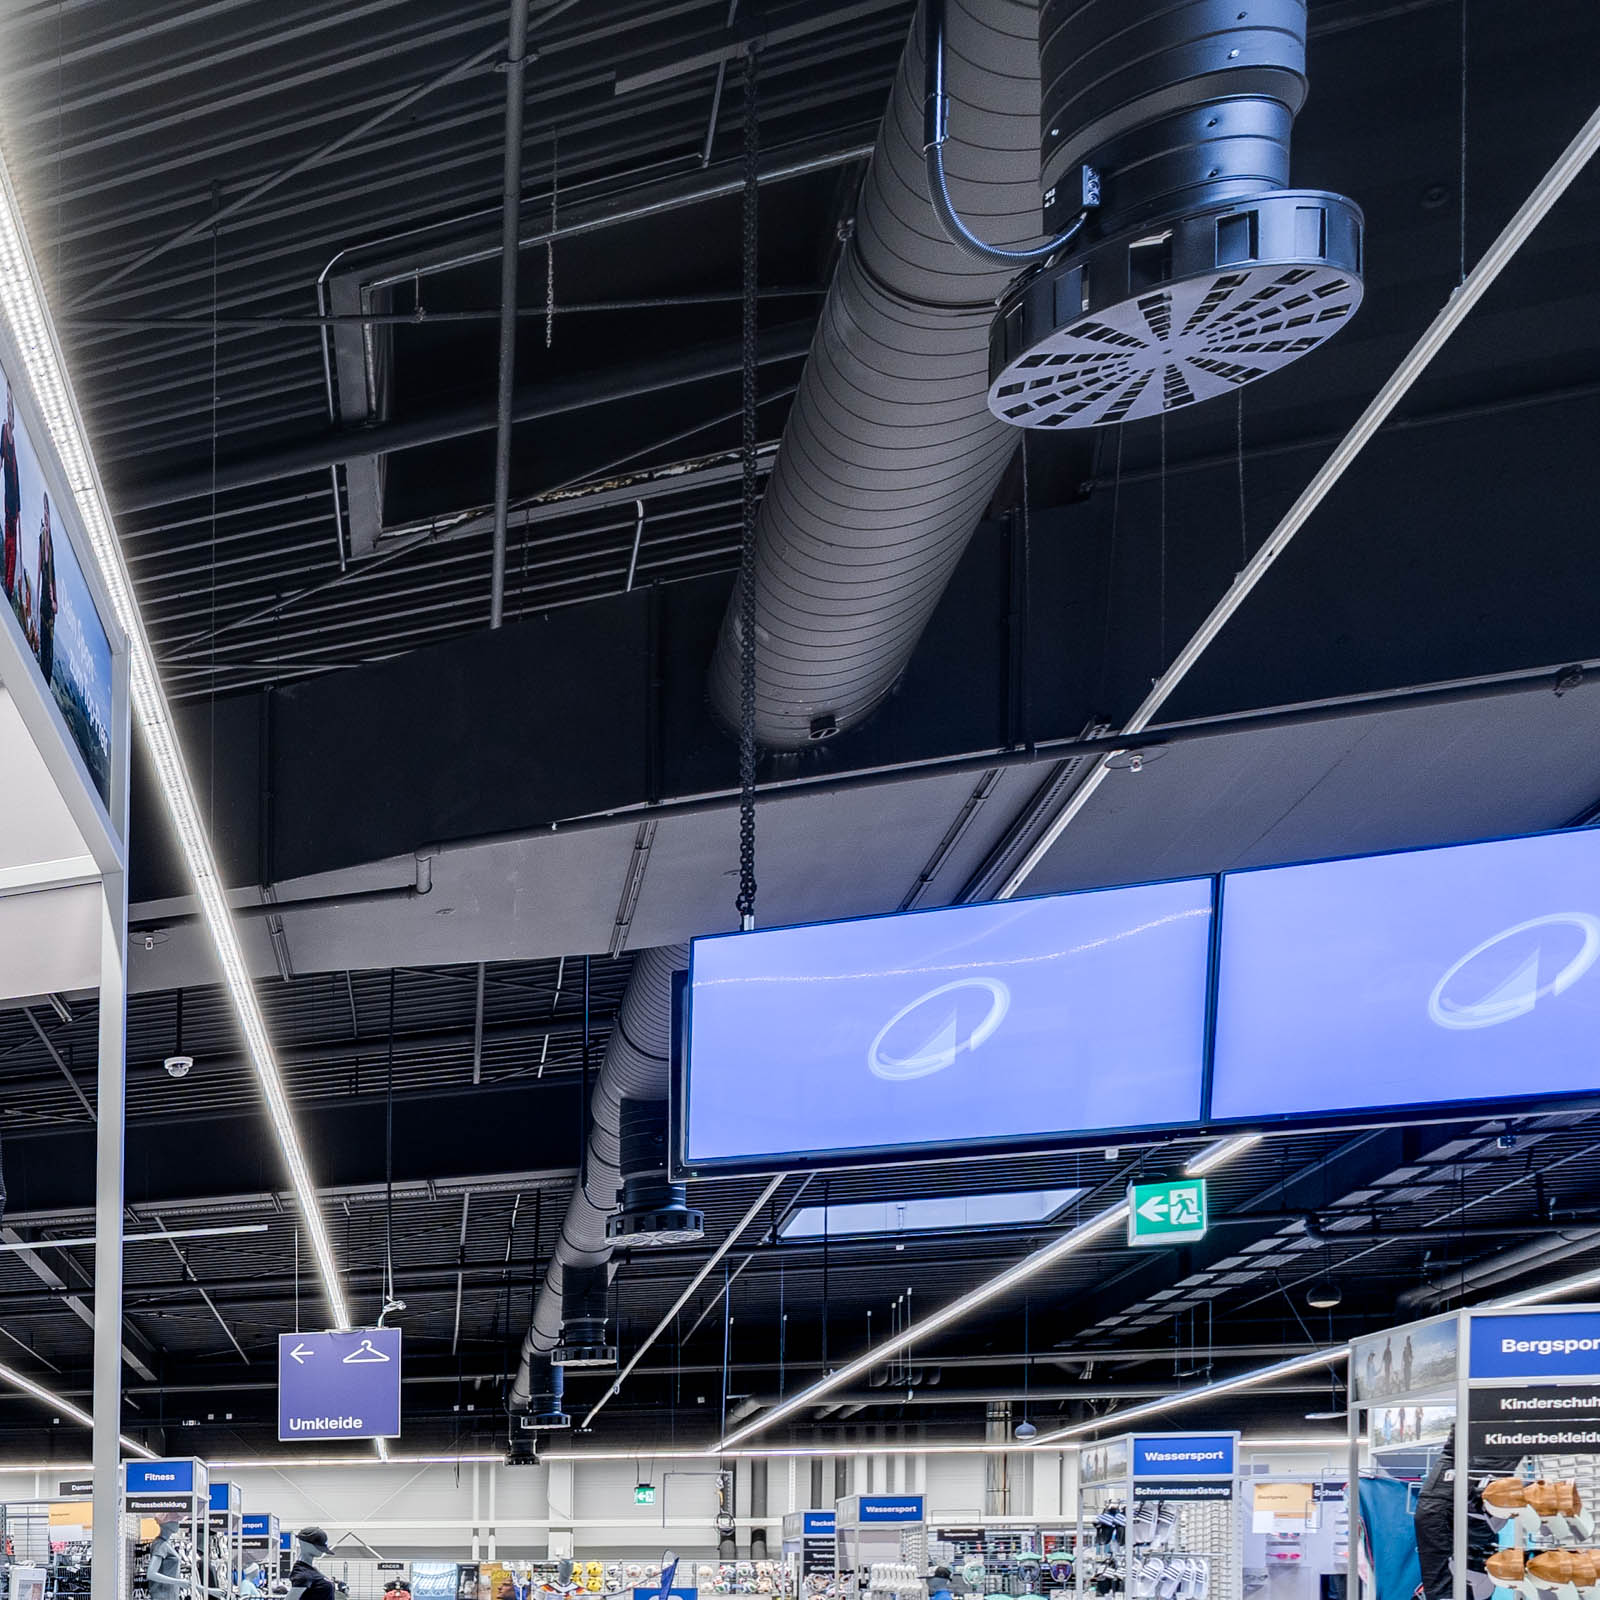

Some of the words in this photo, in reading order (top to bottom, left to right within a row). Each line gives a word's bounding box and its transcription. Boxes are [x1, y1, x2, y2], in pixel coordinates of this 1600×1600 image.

[288, 1415, 363, 1431] Umkleide
[1144, 1450, 1224, 1462] Wassersport
[144, 1472, 176, 1482] Fitness
[1135, 1486, 1230, 1497] Schwimmausrüstung
[865, 1504, 918, 1514] Wassersport
